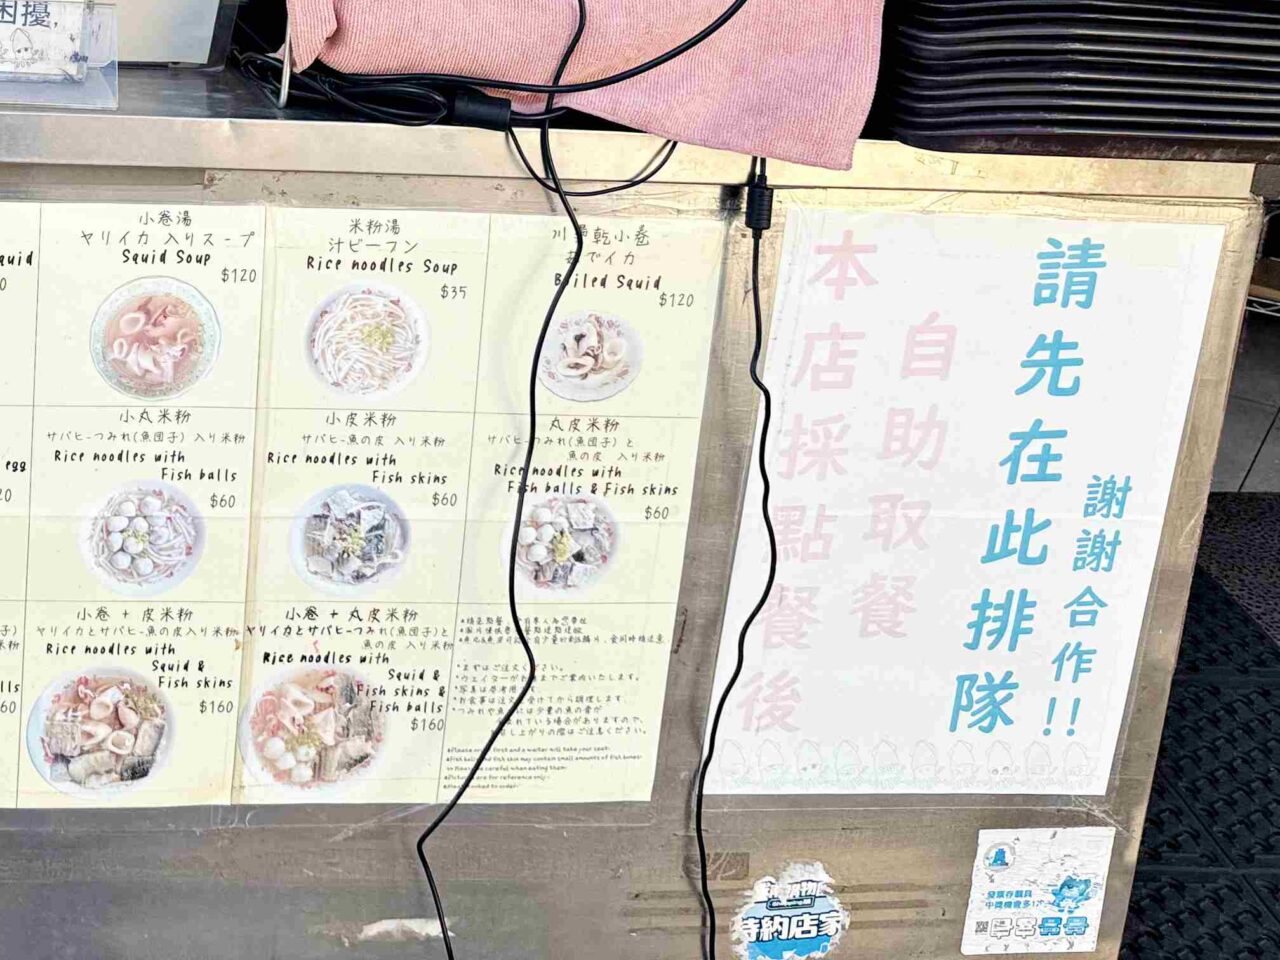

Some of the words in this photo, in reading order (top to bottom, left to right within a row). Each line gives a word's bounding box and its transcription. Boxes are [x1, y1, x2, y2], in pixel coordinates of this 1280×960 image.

[139, 210, 192, 227] 小卷湯
[349, 218, 401, 235] 米粉湯
[122, 249, 167, 265] Squid
[176, 249, 211, 266] Soup
[306, 255, 341, 270] Rice
[351, 257, 413, 272] noodles
[423, 259, 458, 276] Soup
[221, 267, 257, 284] $120
[554, 273, 608, 288] Biled
[616, 274, 662, 290] Squid
[440, 283, 467, 300] $35
[658, 291, 694, 308] $120
[120, 408, 192, 424] 小丸米粉
[325, 411, 397, 428] 小皮米粉
[549, 418, 620, 433] 丸皮米粉
[54, 450, 85, 463] Rice
[93, 450, 146, 463] noodles
[154, 450, 185, 463] with
[267, 451, 297, 465] Rice
[306, 452, 358, 465] noodles
[366, 453, 396, 466] with
[5, 460, 27, 472] egg
[532, 464, 584, 477] noodles
[592, 464, 622, 477] with
[161, 467, 192, 481] Fish
[199, 468, 237, 482] balls
[372, 470, 403, 483] Fish
[410, 472, 448, 485] skins
[736, 230, 880, 734] 本店採點餐後
[850, 311, 958, 640] 自助取餐
[545, 480, 582, 494] balls
[590, 482, 598, 494] &
[603, 482, 634, 495] Fish
[642, 482, 678, 495] skins
[949, 236, 1107, 734] 請先在此排隊
[210, 492, 236, 509] $60
[432, 491, 457, 507] $60
[644, 505, 669, 520] $60
[46, 642, 77, 655] Rice
[84, 643, 137, 655] noodles
[145, 643, 176, 655] with
[151, 659, 189, 672] Squid
[198, 660, 205, 672] &
[262, 651, 294, 665] Rice
[300, 651, 352, 664] noodles
[359, 651, 390, 664] with
[158, 675, 189, 689] Fish
[196, 676, 233, 689] skins
[388, 668, 425, 681] Squid
[433, 669, 441, 681] &
[356, 683, 386, 697] Fish
[394, 683, 430, 697] skins
[438, 685, 446, 697] &
[199, 699, 234, 714] $160
[369, 699, 400, 713] Fish
[406, 700, 443, 713] balls
[410, 717, 445, 731] $160
